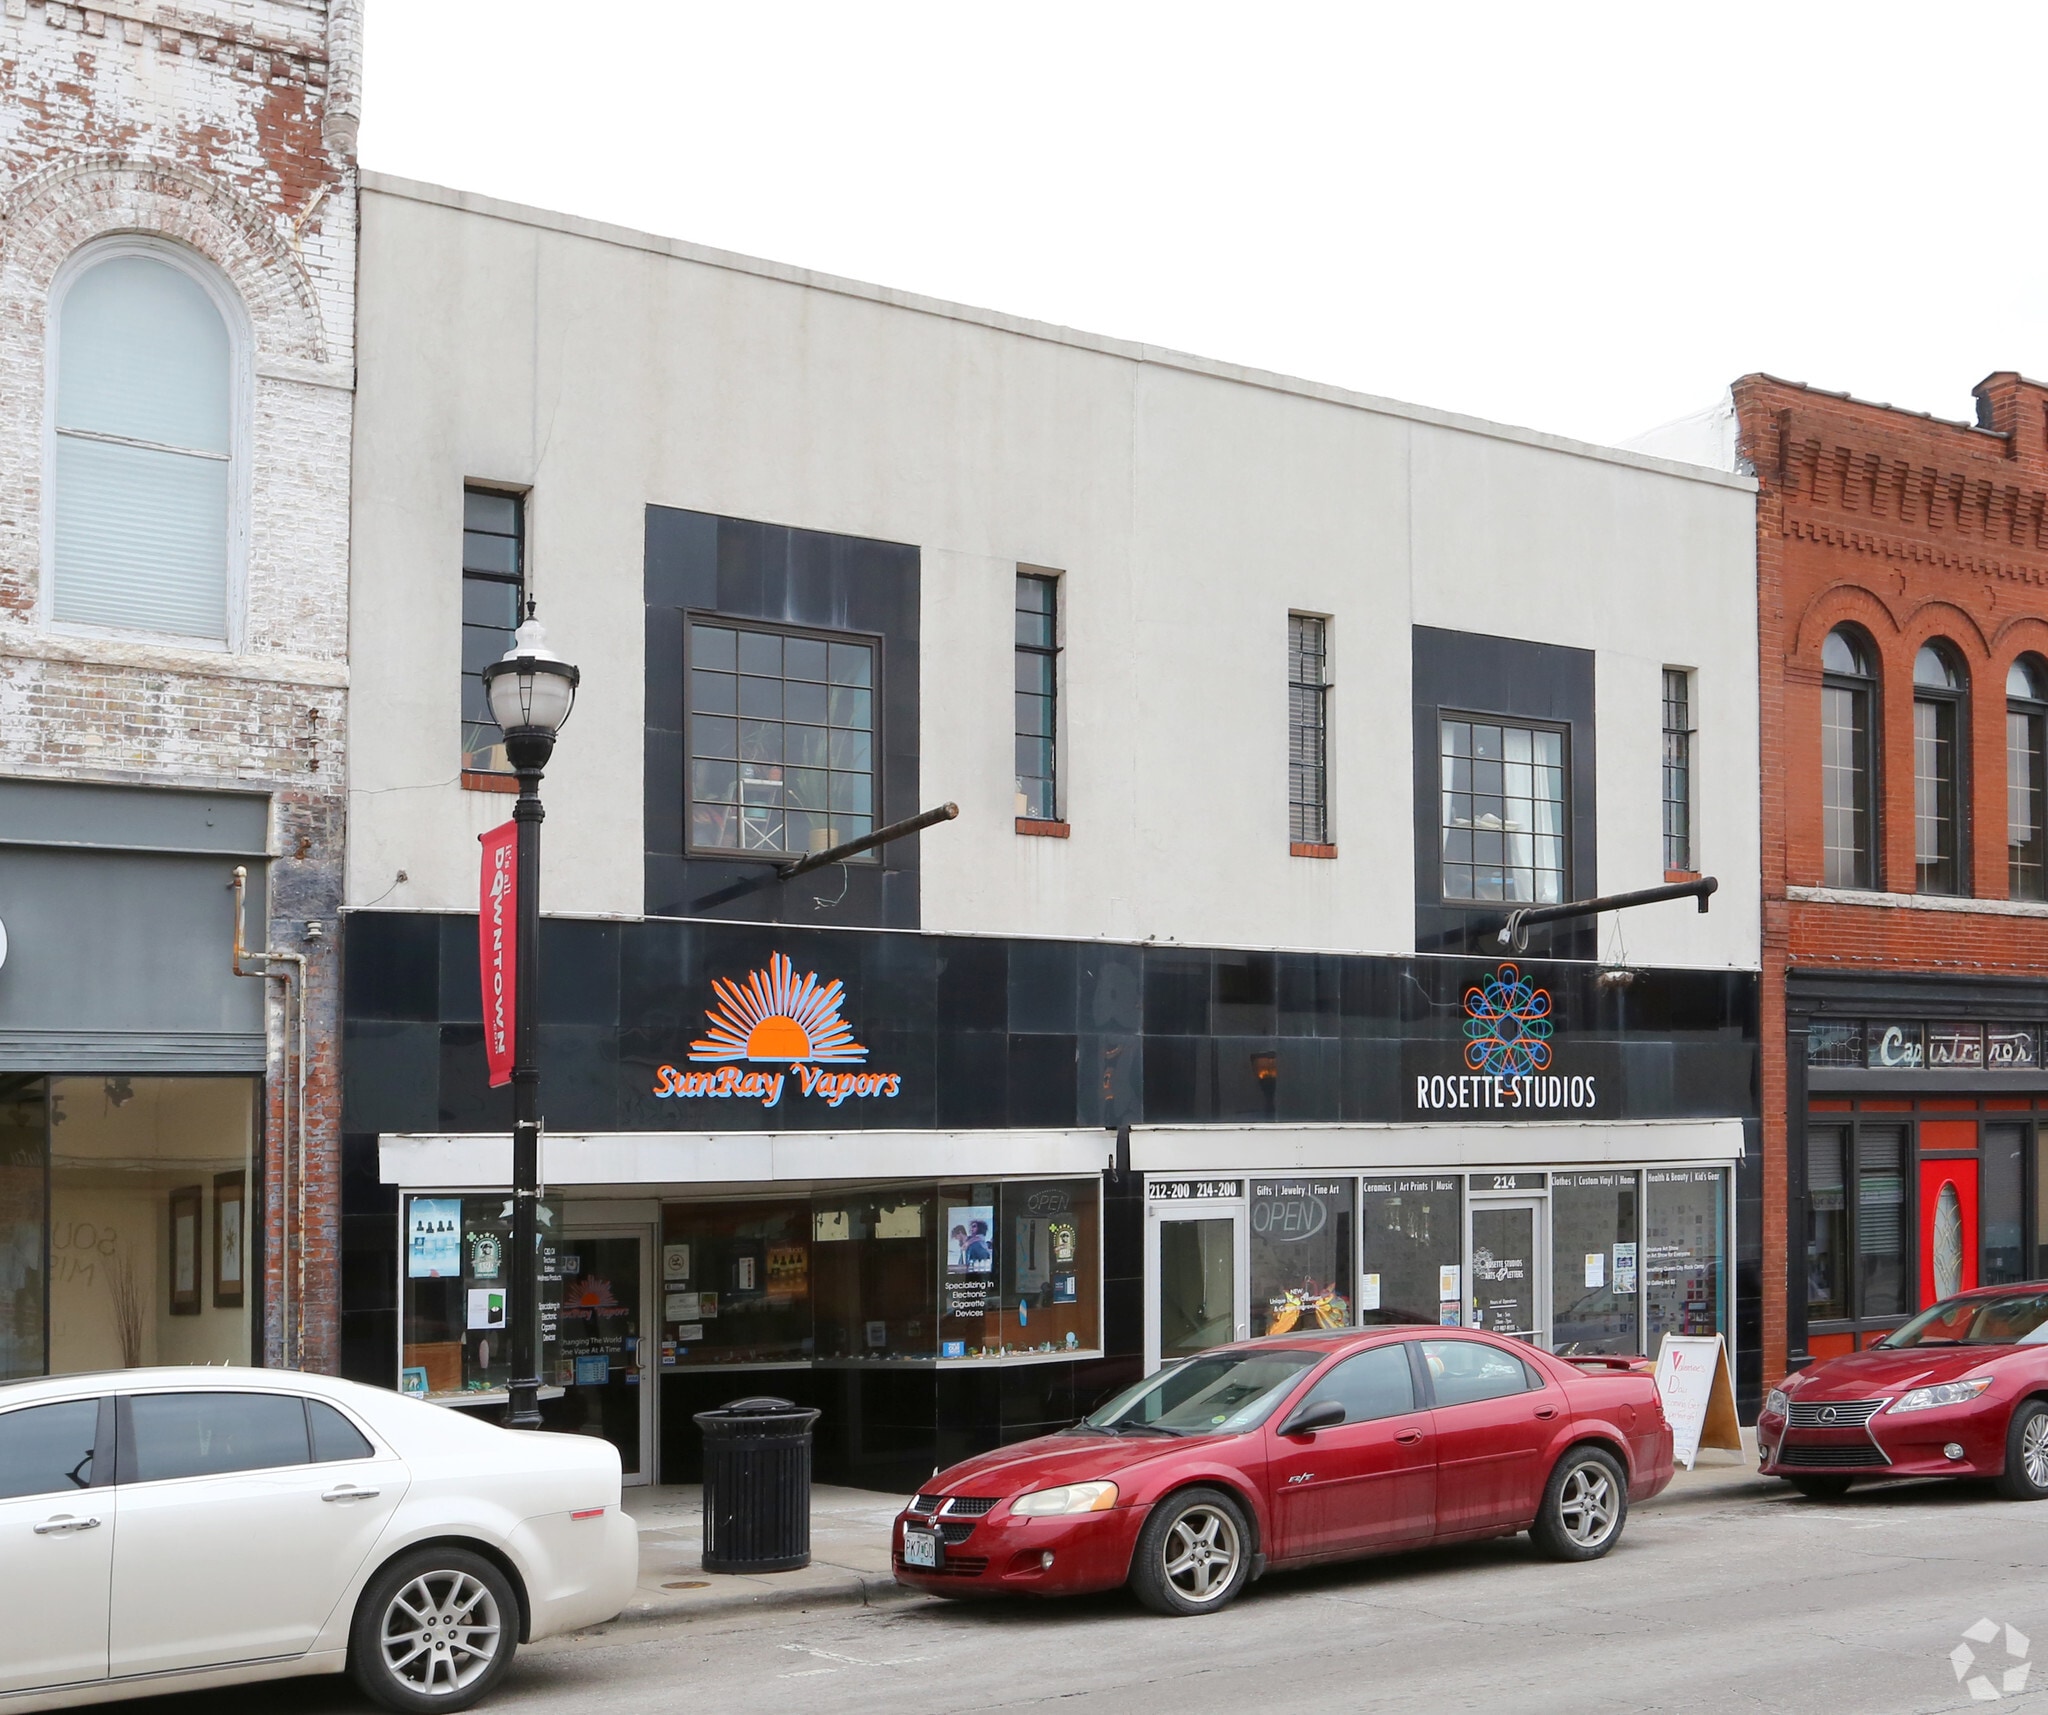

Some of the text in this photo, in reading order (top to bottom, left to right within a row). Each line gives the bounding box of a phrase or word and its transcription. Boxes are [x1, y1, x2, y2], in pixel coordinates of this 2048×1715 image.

[504, 874, 512, 896] all
[490, 847, 506, 1055] DOWNTOWN
[1880, 1026, 2032, 1068] Capistrano's
[653, 1062, 901, 1107] SunRay Vapors
[1417, 1076, 1597, 1109] ROSETTE STUDIOS
[1493, 1176, 1516, 1189] 214
[1551, 1175, 1635, 1186] Clothes Custom Vinyl Home
[1647, 1172, 1720, 1183] Health & Beauty Kid's Gear
[1149, 1182, 1237, 1199] 212-200 214-200
[1256, 1185, 1340, 1197] Gifts Jewelry Fine Art
[1363, 1181, 1453, 1192] Ceramics Art Prints Music
[1027, 1194, 1069, 1212] OPEN
[1253, 1201, 1315, 1232] OPEN
[945, 1281, 986, 1291] Specializing
[952, 1291, 987, 1299] Electronic
[951, 1300, 985, 1309] Cigarette
[955, 1309, 984, 1317] Devices
[603, 1336, 622, 1344] World
[574, 1348, 590, 1356] Vape
[1288, 1472, 1315, 1484] R/T
